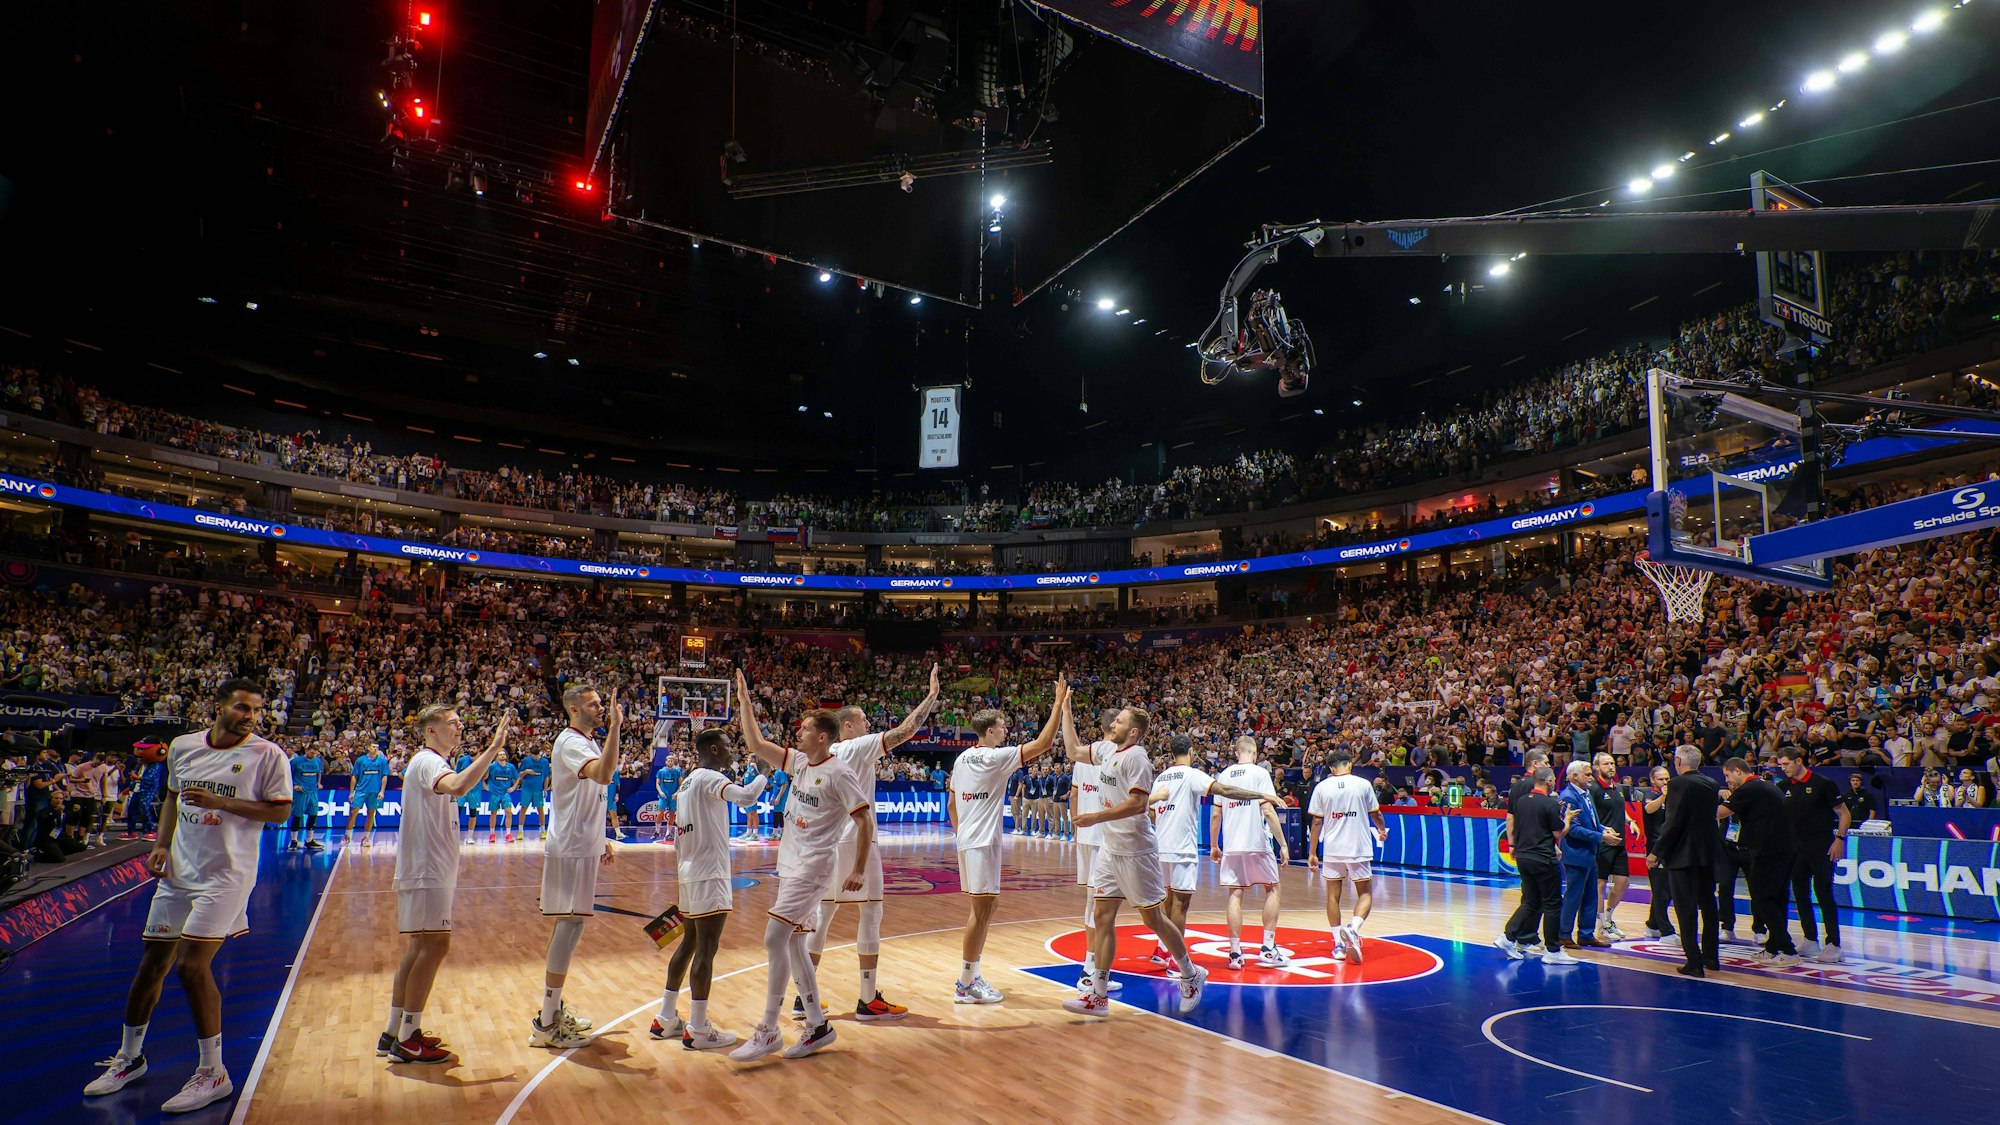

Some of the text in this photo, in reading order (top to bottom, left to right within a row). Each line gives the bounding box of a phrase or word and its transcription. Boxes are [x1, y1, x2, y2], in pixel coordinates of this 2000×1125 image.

[1386, 228, 1429, 249] TRIANGLE
[1790, 305, 1833, 337] TISSOT
[932, 408, 949, 429] 14
[195, 514, 269, 534] GERMANY
[1512, 508, 1578, 529] GERMANY
[1913, 510, 1976, 530] Schelde
[401, 545, 465, 560] GERMANY
[1340, 543, 1397, 559] GERMANY
[579, 564, 637, 576] GERMANY
[1184, 564, 1237, 575] GERMANY
[740, 575, 793, 584] GERMANY
[891, 579, 941, 587] GERMANY
[1036, 576, 1087, 584] GERMANY
[687, 639, 704, 647] 6:25
[1230, 769, 1246, 778] GIFFEY
[1082, 782, 1099, 793] tipwi
[962, 791, 989, 802] tipwin
